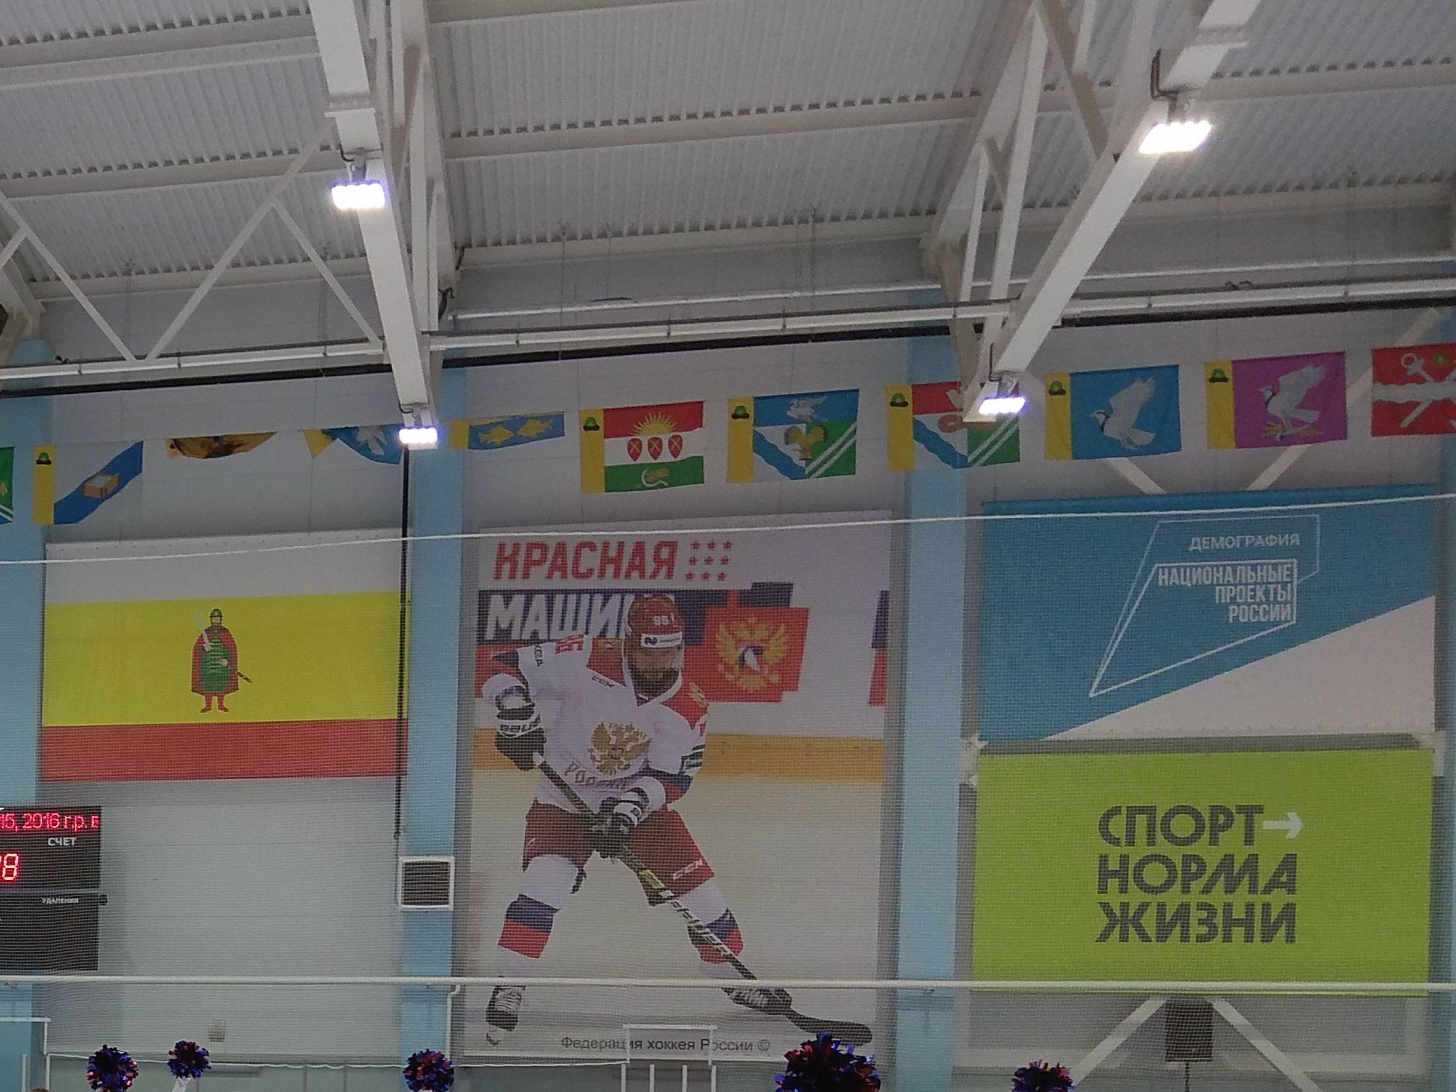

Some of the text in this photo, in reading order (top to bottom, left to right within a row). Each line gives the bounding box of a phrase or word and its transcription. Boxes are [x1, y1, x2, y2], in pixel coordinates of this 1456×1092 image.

[1189, 533, 1301, 552] ДЕМОГРАФИЯ
[493, 540, 678, 581] КРАСНАЯ
[1157, 563, 1292, 587] НАЦИОНАЛЬНЫЕ
[1215, 583, 1292, 604] ПРОЕКТЫ
[1228, 603, 1292, 624] РОССИИ
[22, 812, 60, 829] 2016
[1098, 804, 1264, 848] СПОРТ
[48, 837, 77, 847] СЧЕТ
[1096, 853, 1297, 895] НОРМА
[1095, 902, 1297, 943] ЖИЗНИ
[561, 1036, 643, 1051] Федерация
[647, 1038, 695, 1050] хоккея
